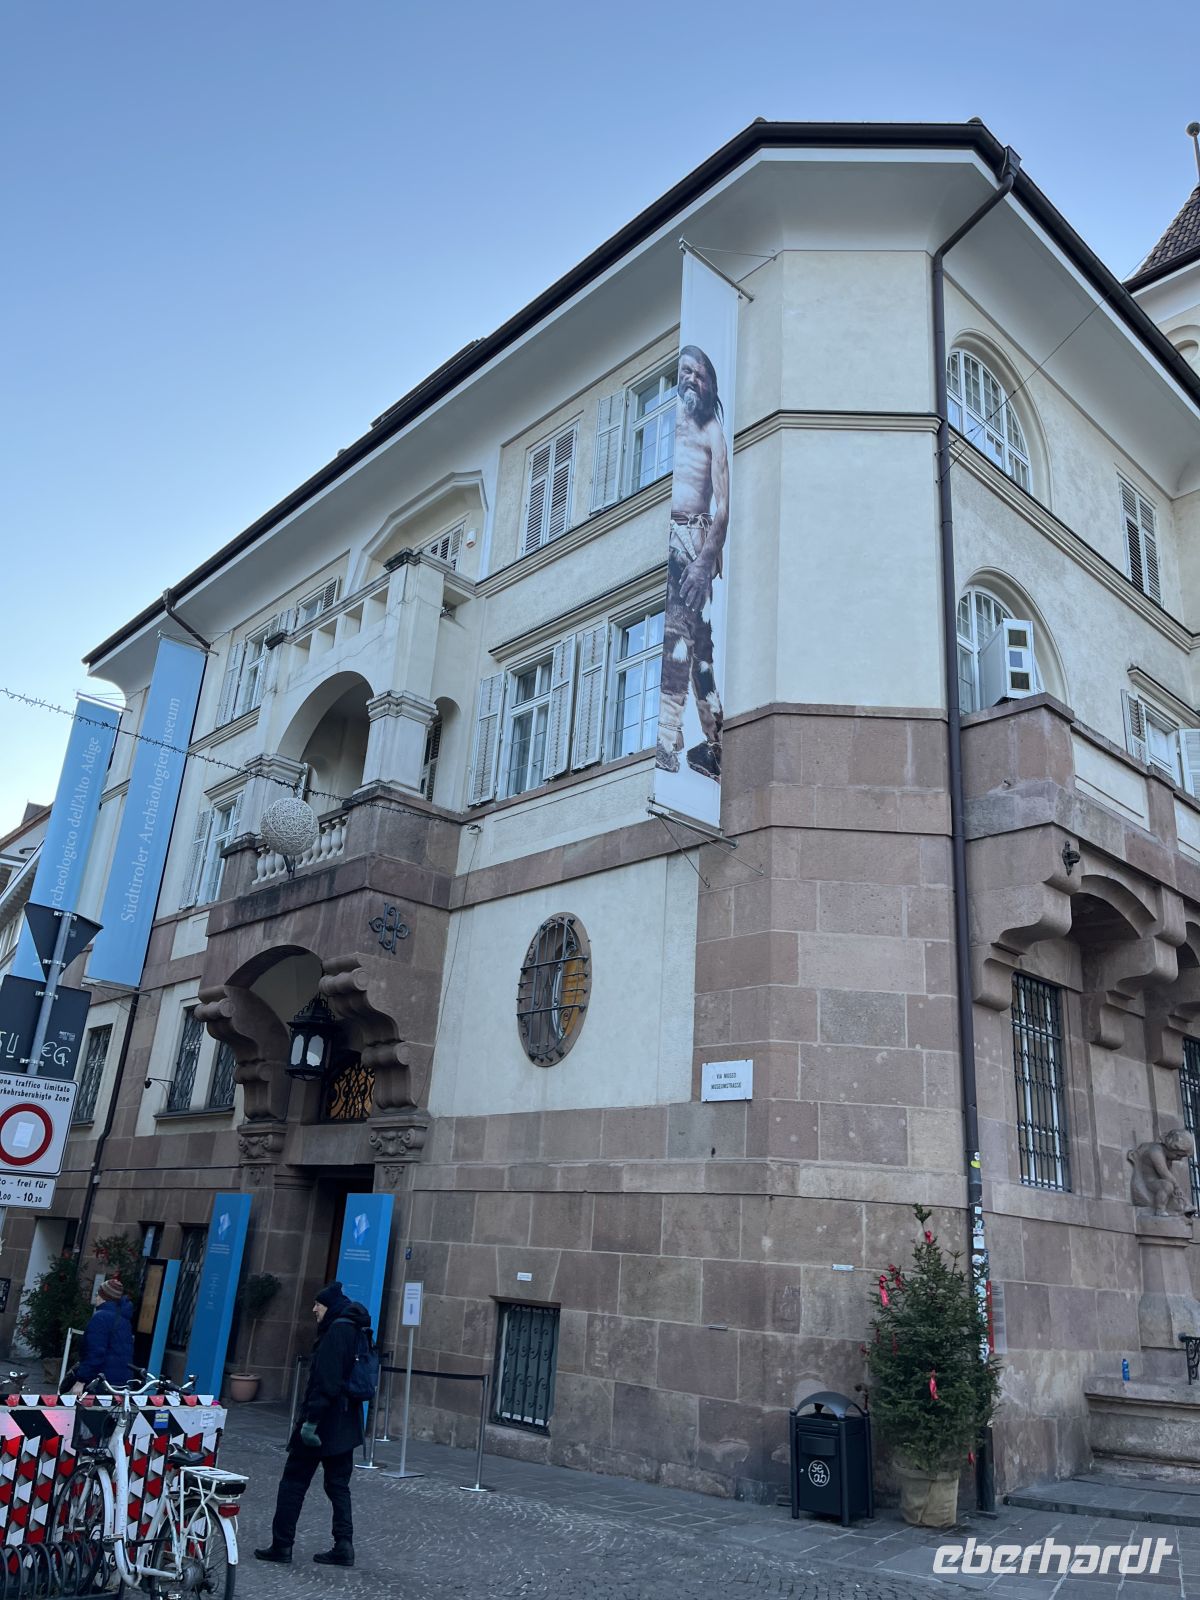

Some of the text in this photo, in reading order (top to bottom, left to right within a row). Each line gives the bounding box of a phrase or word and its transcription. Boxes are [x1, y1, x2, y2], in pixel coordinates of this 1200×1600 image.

[81, 736, 101, 775] Adige
[120, 846, 149, 923] Südtiroler
[15, 1079, 41, 1089] traffico
[44, 1082, 71, 1093] limitato
[55, 1093, 70, 1103] Zone
[17, 1179, 32, 1188] frei
[35, 1180, 47, 1188] für
